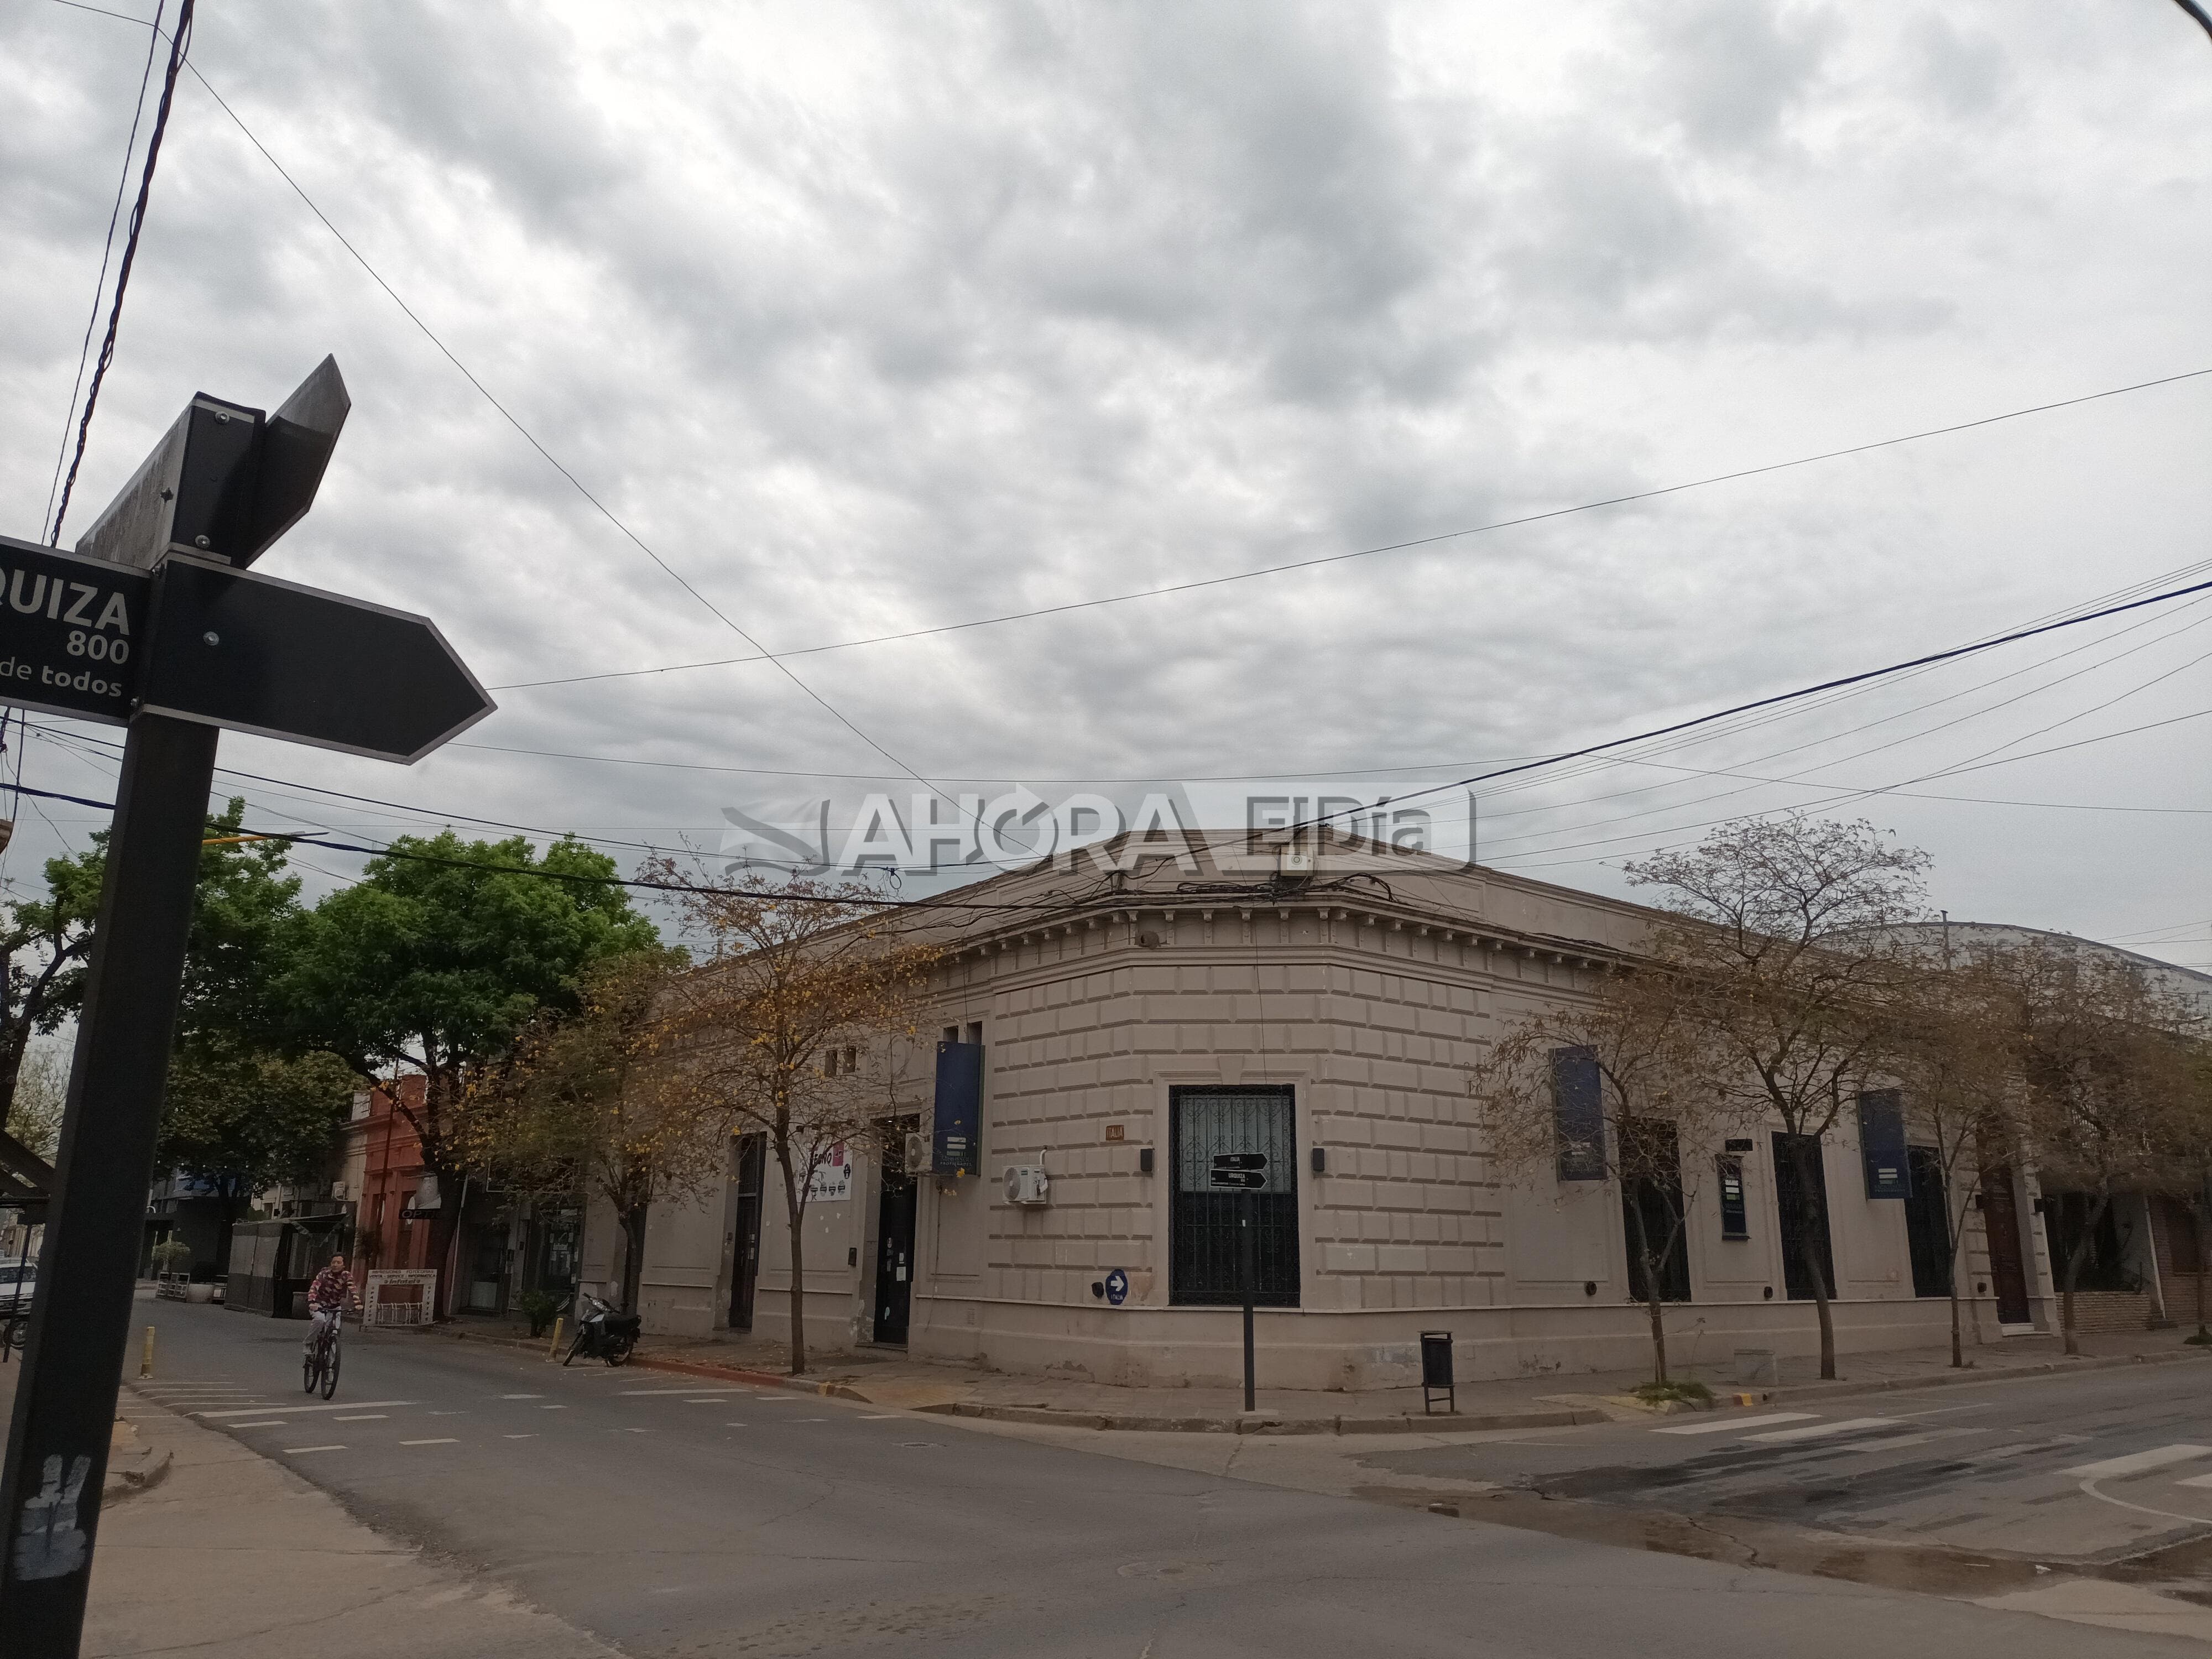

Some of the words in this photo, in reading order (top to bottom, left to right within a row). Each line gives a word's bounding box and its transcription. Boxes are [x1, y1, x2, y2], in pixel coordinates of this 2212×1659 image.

[0, 565, 129, 635] UIZA
[67, 630, 129, 664] 800
[0, 656, 32, 680] de
[41, 665, 123, 697] todos
[1107, 1127, 1123, 1138] ITALIA
